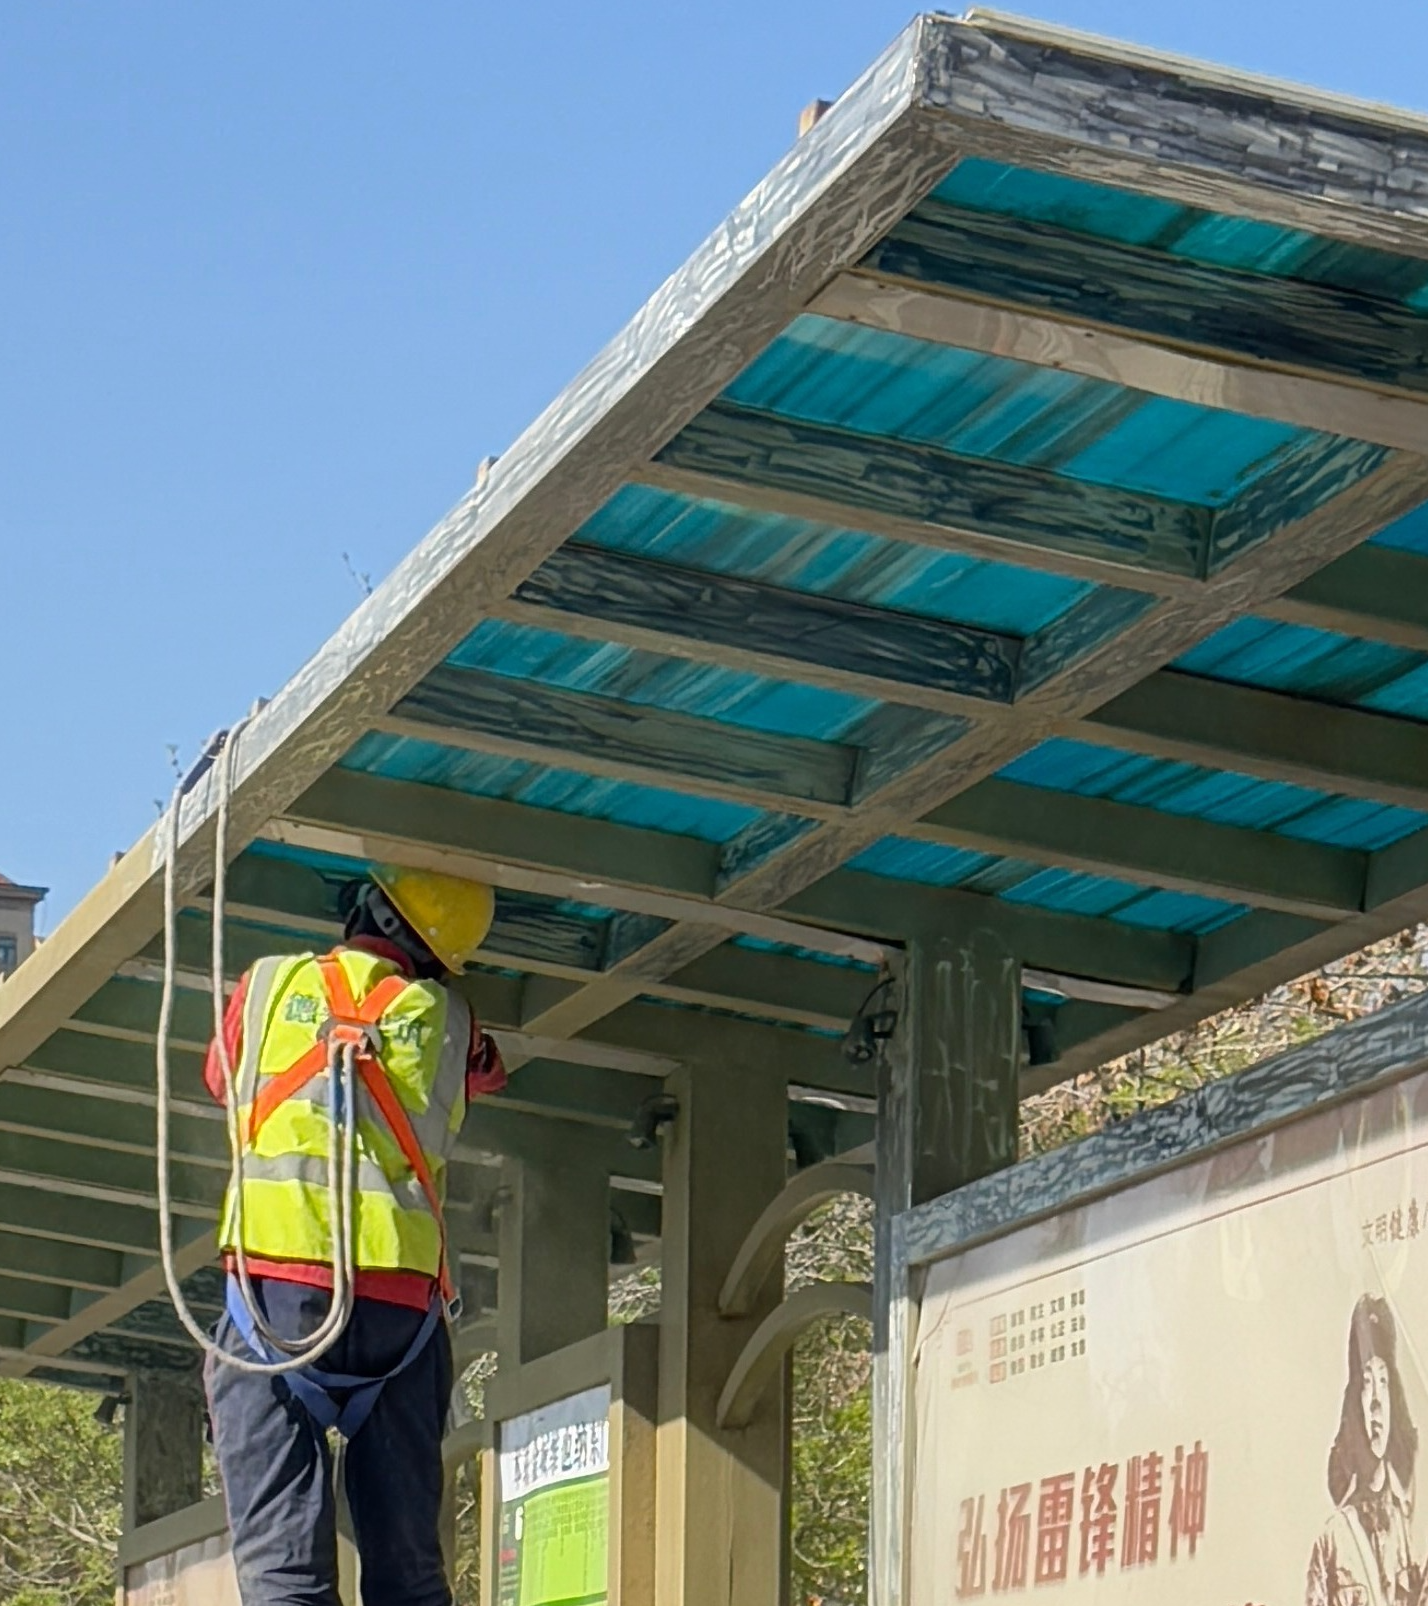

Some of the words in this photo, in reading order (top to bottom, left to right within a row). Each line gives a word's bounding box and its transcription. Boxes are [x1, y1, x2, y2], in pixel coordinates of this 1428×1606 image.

[956, 1440, 1208, 1598] 弘扬雷锋精神
